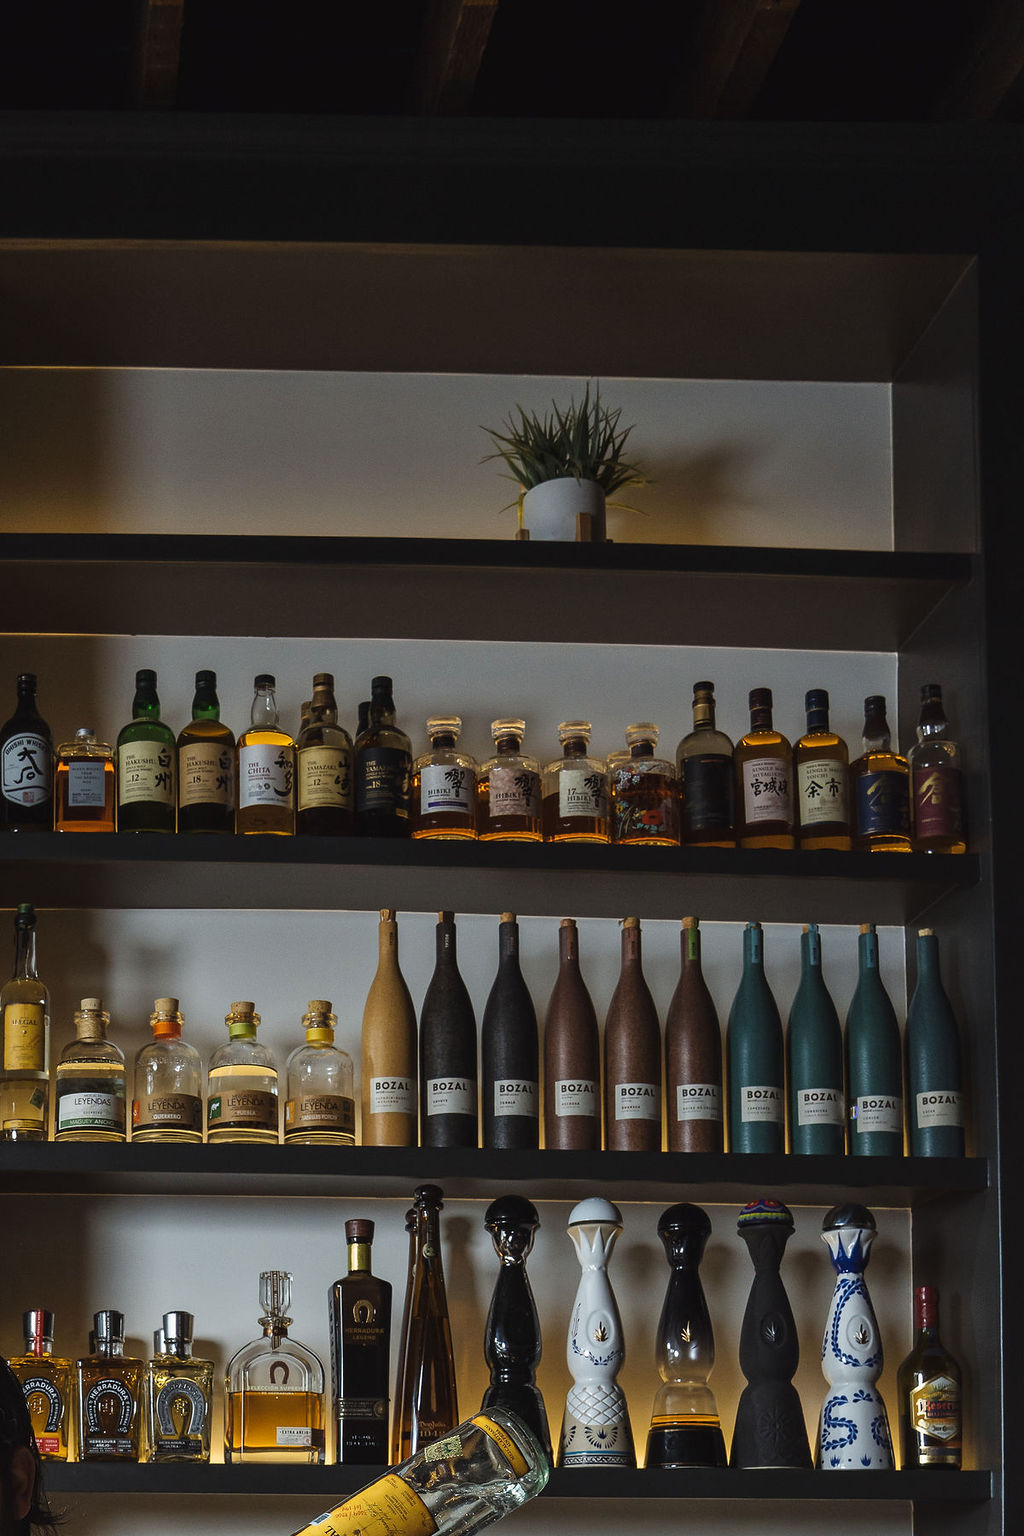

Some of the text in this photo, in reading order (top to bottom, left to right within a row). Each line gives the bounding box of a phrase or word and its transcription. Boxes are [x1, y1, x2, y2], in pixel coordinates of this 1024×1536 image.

[247, 767, 271, 775] CHITA
[130, 774, 140, 783] 12
[192, 776, 201, 784] 18
[375, 1081, 410, 1091] BOZAL
[432, 1081, 467, 1092] BOZAL
[499, 1084, 533, 1094] BOZAL
[561, 1084, 594, 1094] BOZAL
[621, 1087, 655, 1097] BOZAL
[682, 1089, 716, 1098] BOZAL
[747, 1090, 780, 1099] BOZAL
[74, 1098, 112, 1107] LEYENDAS
[227, 1098, 265, 1107] LEYENDA
[804, 1093, 838, 1103] BOZAL
[922, 1095, 959, 1106] BOZAL
[148, 1101, 186, 1111] LEYENDA
[300, 1102, 338, 1111] LEYENDA
[862, 1099, 896, 1109] BOZAL
[22, 1381, 57, 1399] ERRADURA
[89, 1382, 129, 1401] HERRADURA
